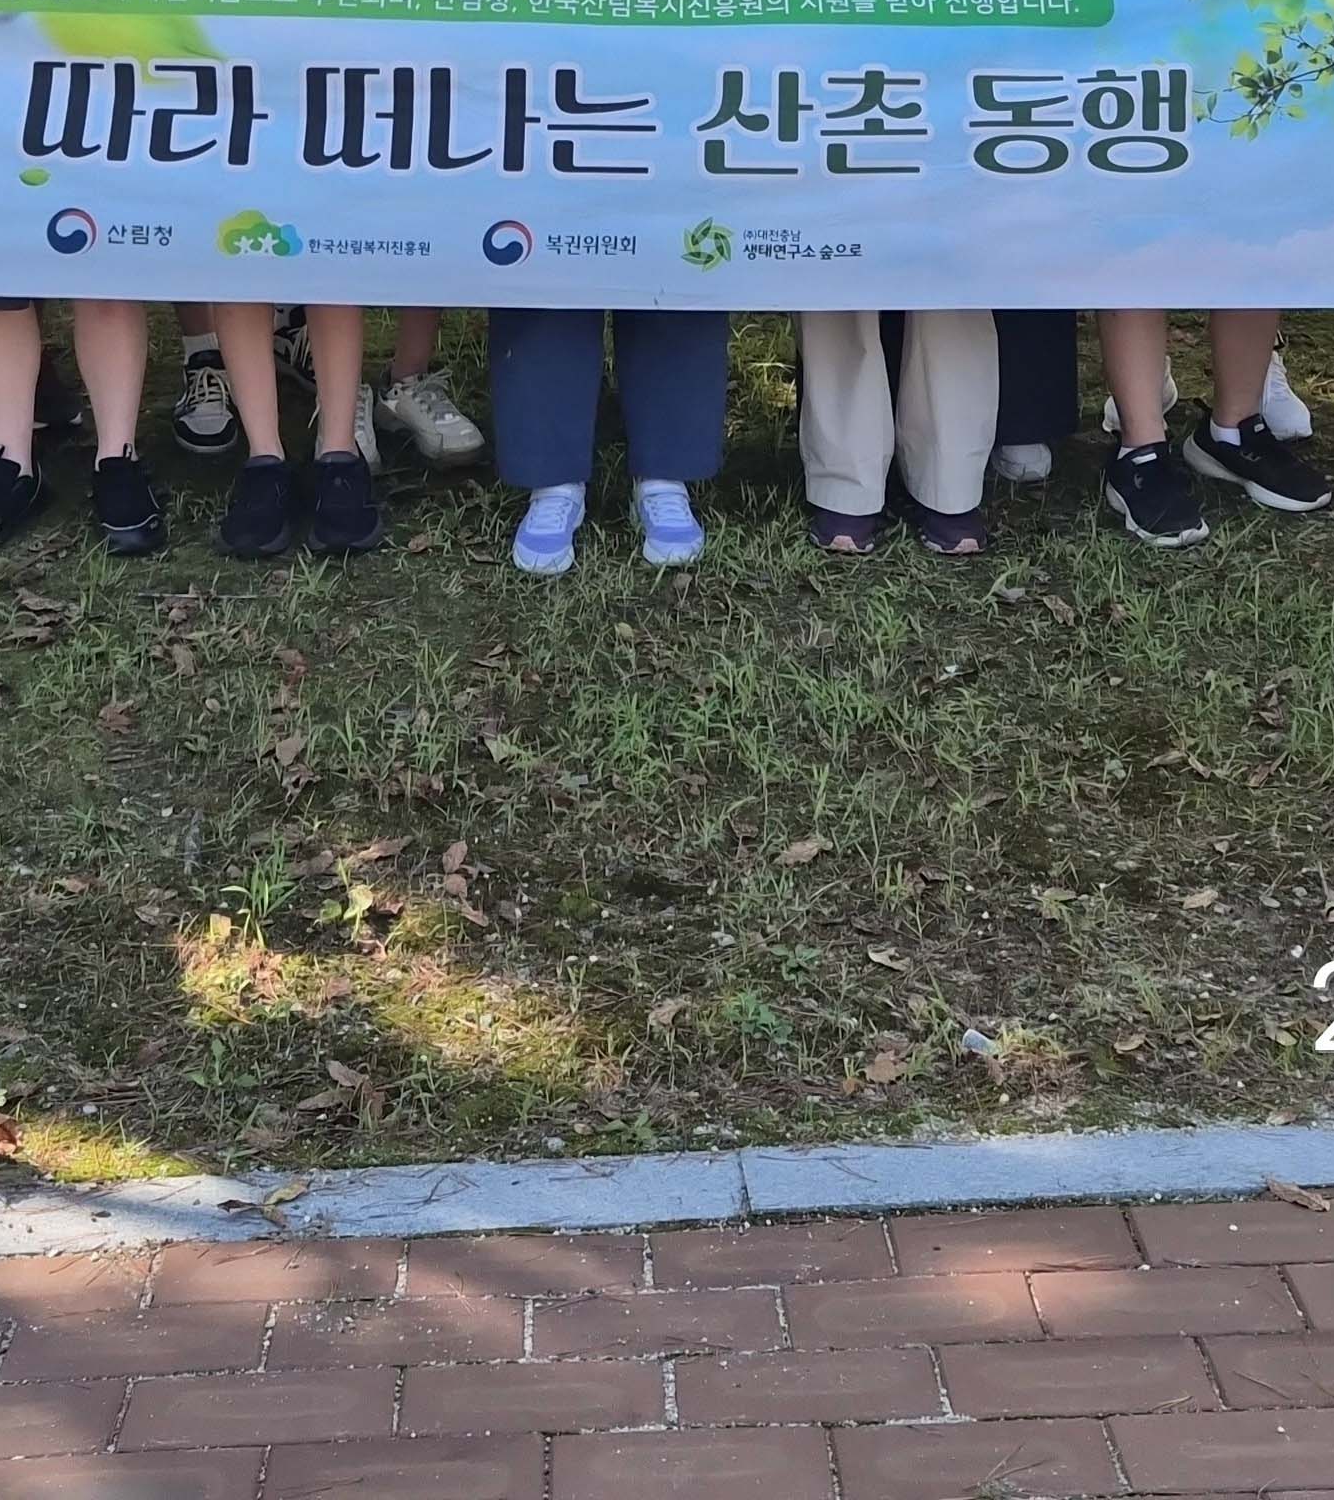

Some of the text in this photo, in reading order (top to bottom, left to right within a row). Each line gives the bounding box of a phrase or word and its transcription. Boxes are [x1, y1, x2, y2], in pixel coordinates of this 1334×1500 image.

[22, 61, 269, 166] 따라
[303, 67, 657, 174] 떠나는
[696, 70, 928, 175] 산촌
[969, 68, 1190, 175] 동행
[107, 225, 173, 247] 산림청
[546, 234, 637, 257] 복권위원회
[308, 238, 431, 257] 한국산림복지진흥원
[743, 244, 863, 260] 생태연구소 숲으로
